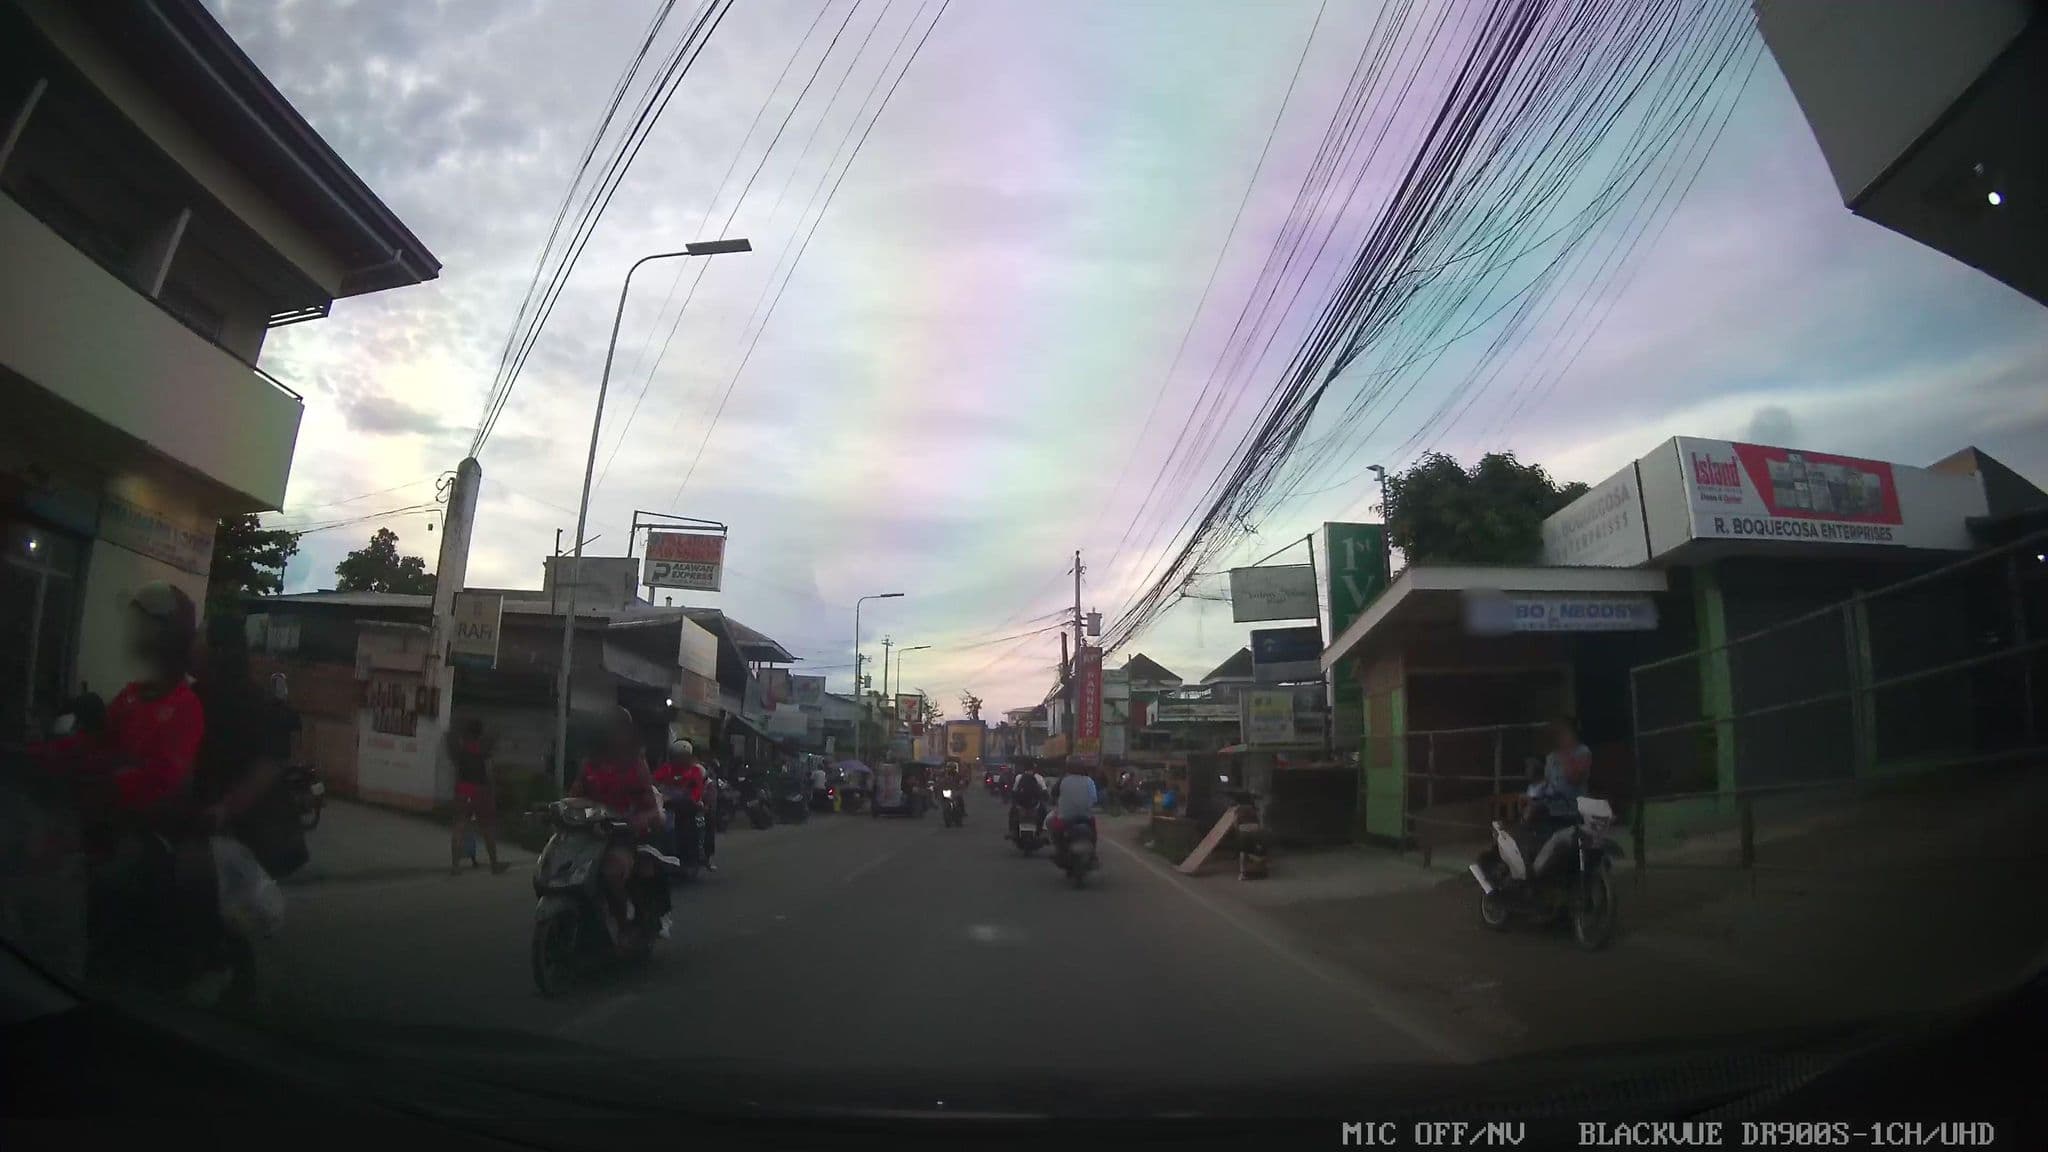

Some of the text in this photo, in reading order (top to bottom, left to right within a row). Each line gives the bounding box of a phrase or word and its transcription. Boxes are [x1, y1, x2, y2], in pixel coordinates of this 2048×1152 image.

[1692, 452, 1741, 487] Island
[1714, 517, 1893, 541] R. BOQUECOSA ENTERPRISES
[672, 571, 713, 580] EXPRESS
